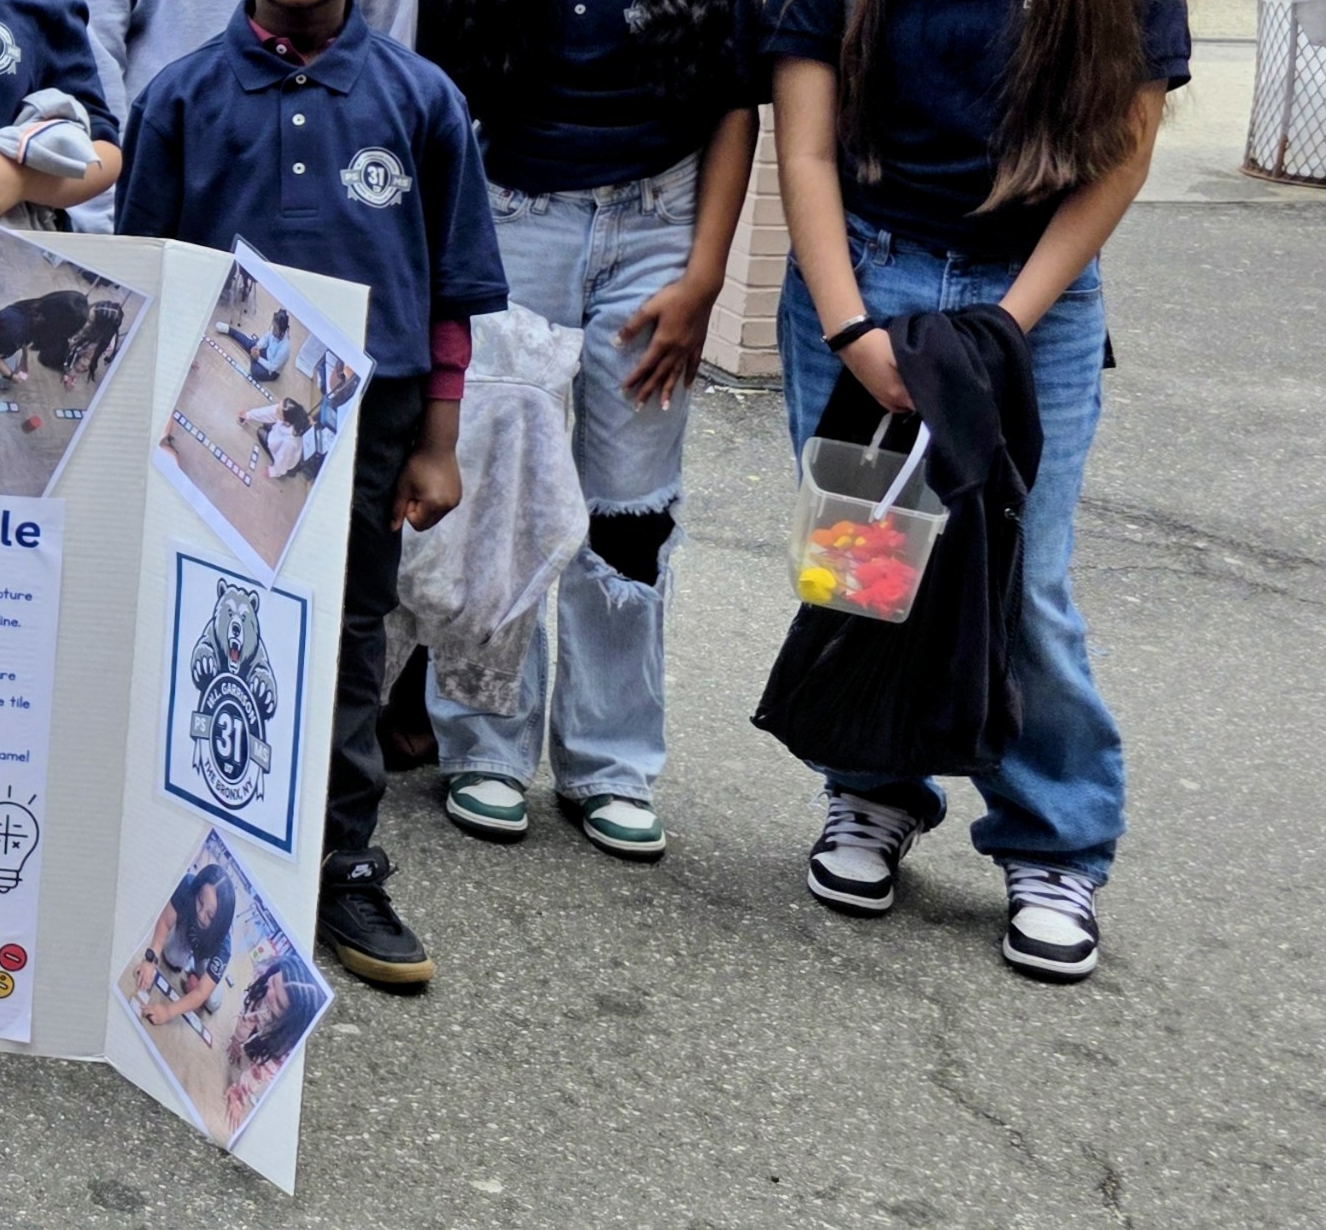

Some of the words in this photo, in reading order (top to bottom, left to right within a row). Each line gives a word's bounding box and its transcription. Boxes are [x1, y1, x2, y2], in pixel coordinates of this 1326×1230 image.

[366, 165, 385, 186] 31
[9, 695, 30, 709] tile
[220, 682, 257, 725] GARRISON
[194, 716, 207, 732] PS
[216, 712, 242, 764] 31
[253, 740, 270, 763] MS
[204, 757, 216, 783] THE
[242, 776, 254, 797] NY
